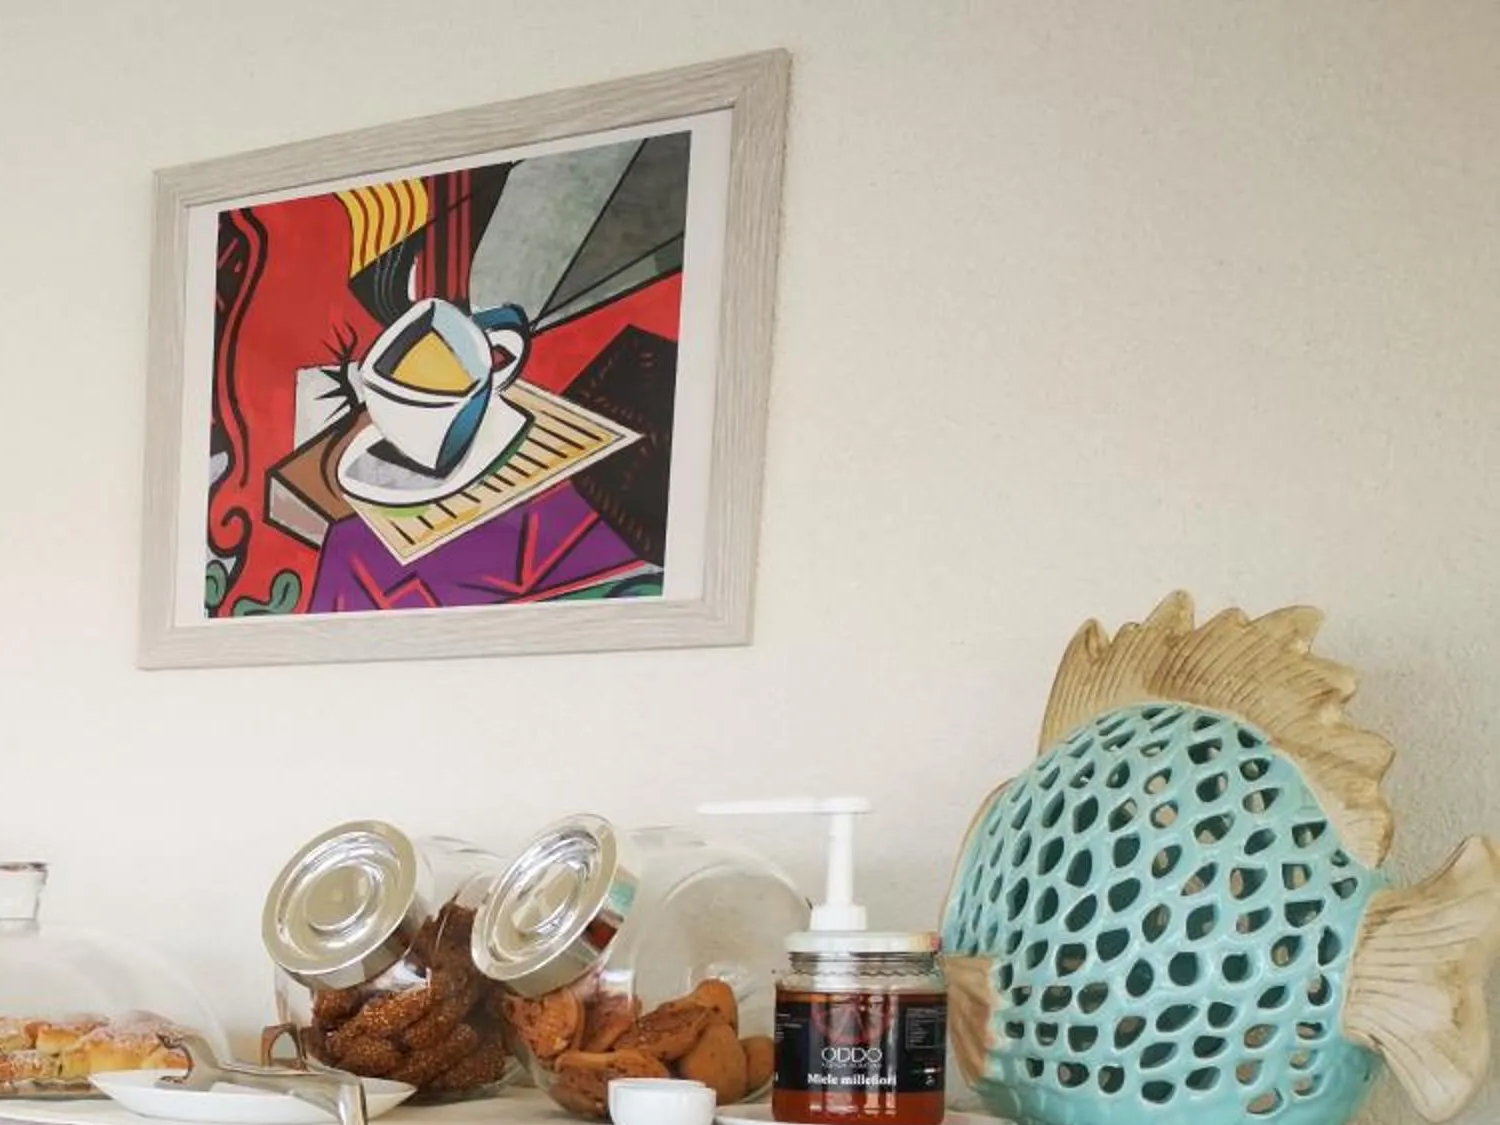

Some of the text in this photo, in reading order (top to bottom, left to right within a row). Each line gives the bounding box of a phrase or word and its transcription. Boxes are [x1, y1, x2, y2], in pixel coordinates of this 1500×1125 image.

[821, 1047, 883, 1063] ODDO
[807, 1072, 897, 1087] Miele millefiori
